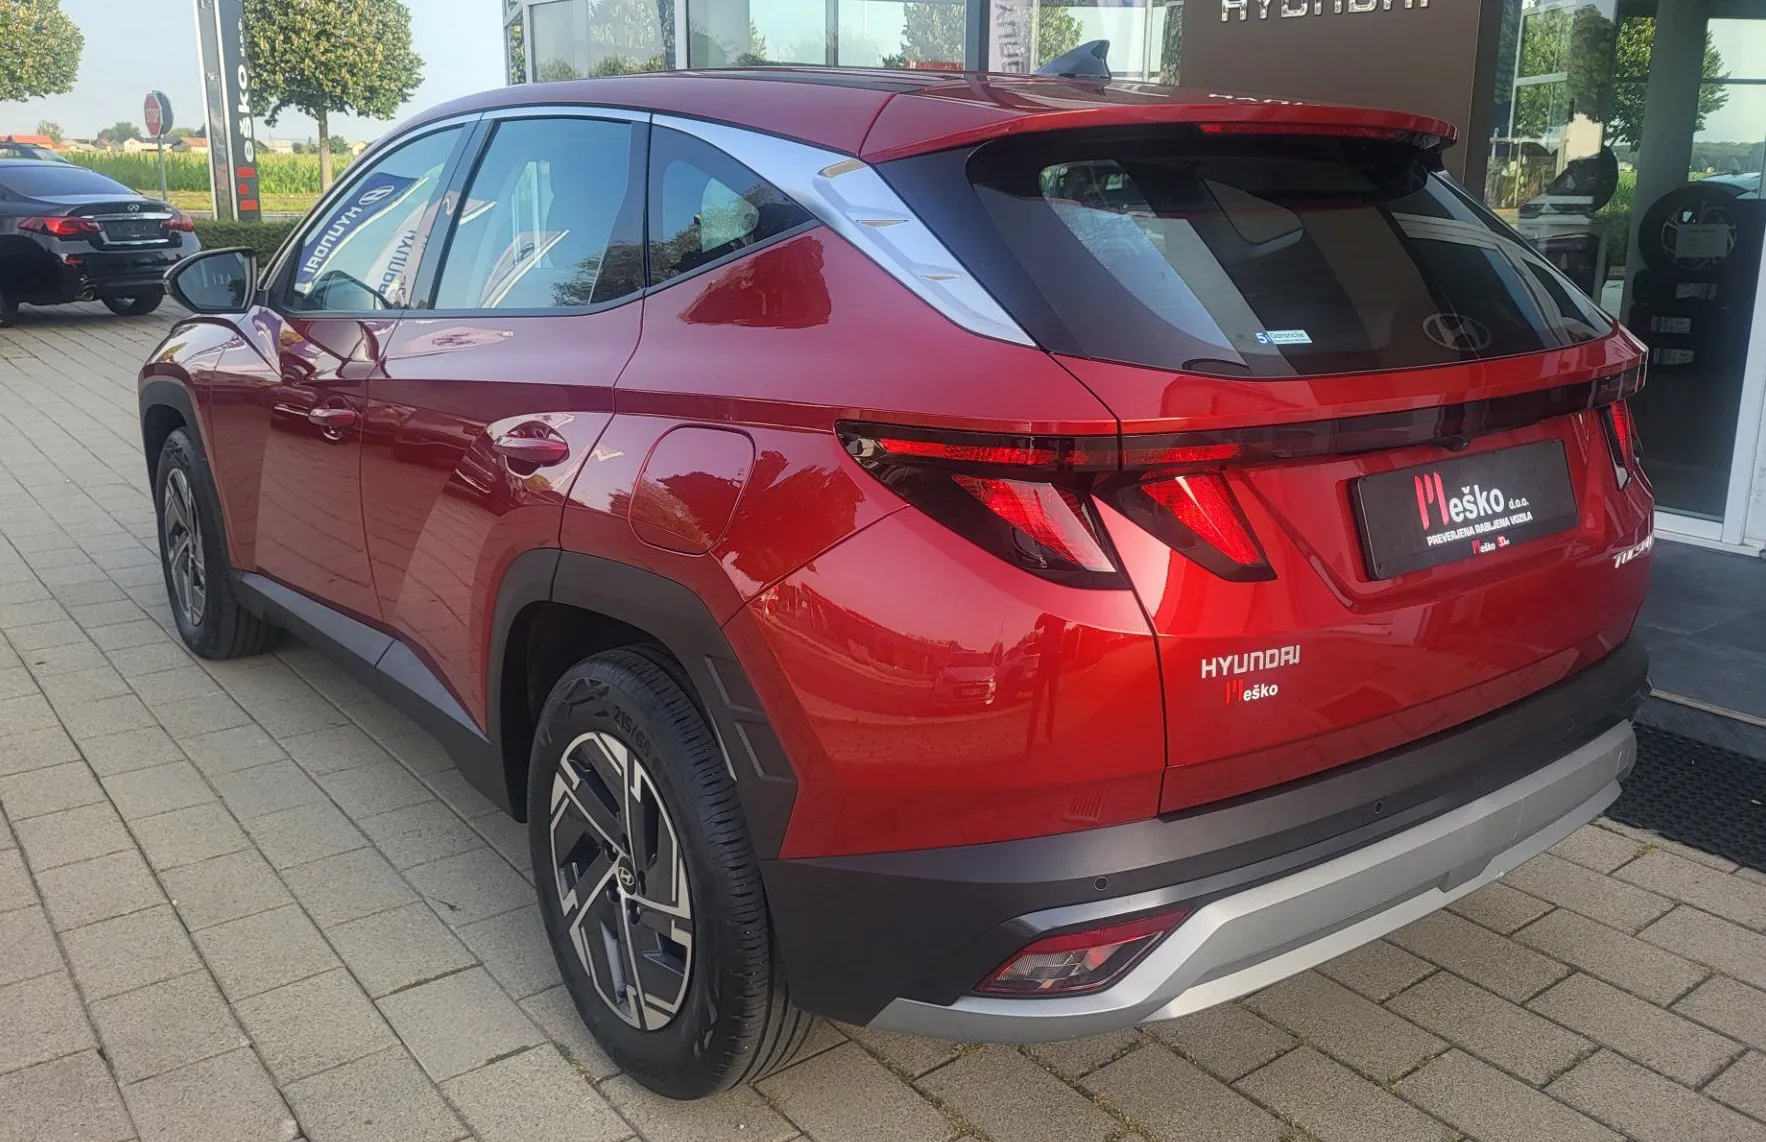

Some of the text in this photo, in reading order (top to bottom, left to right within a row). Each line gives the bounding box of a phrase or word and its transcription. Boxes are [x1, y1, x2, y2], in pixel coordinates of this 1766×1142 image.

[145, 107, 160, 124] STOP
[1255, 332, 1268, 344] 5
[1414, 471, 1530, 531] Meško d.o.o.
[1426, 511, 1534, 546] PREVERJENA RABLJENA VOZILA
[1201, 644, 1301, 679] HYUNDAI
[1226, 679, 1279, 704] Meško
